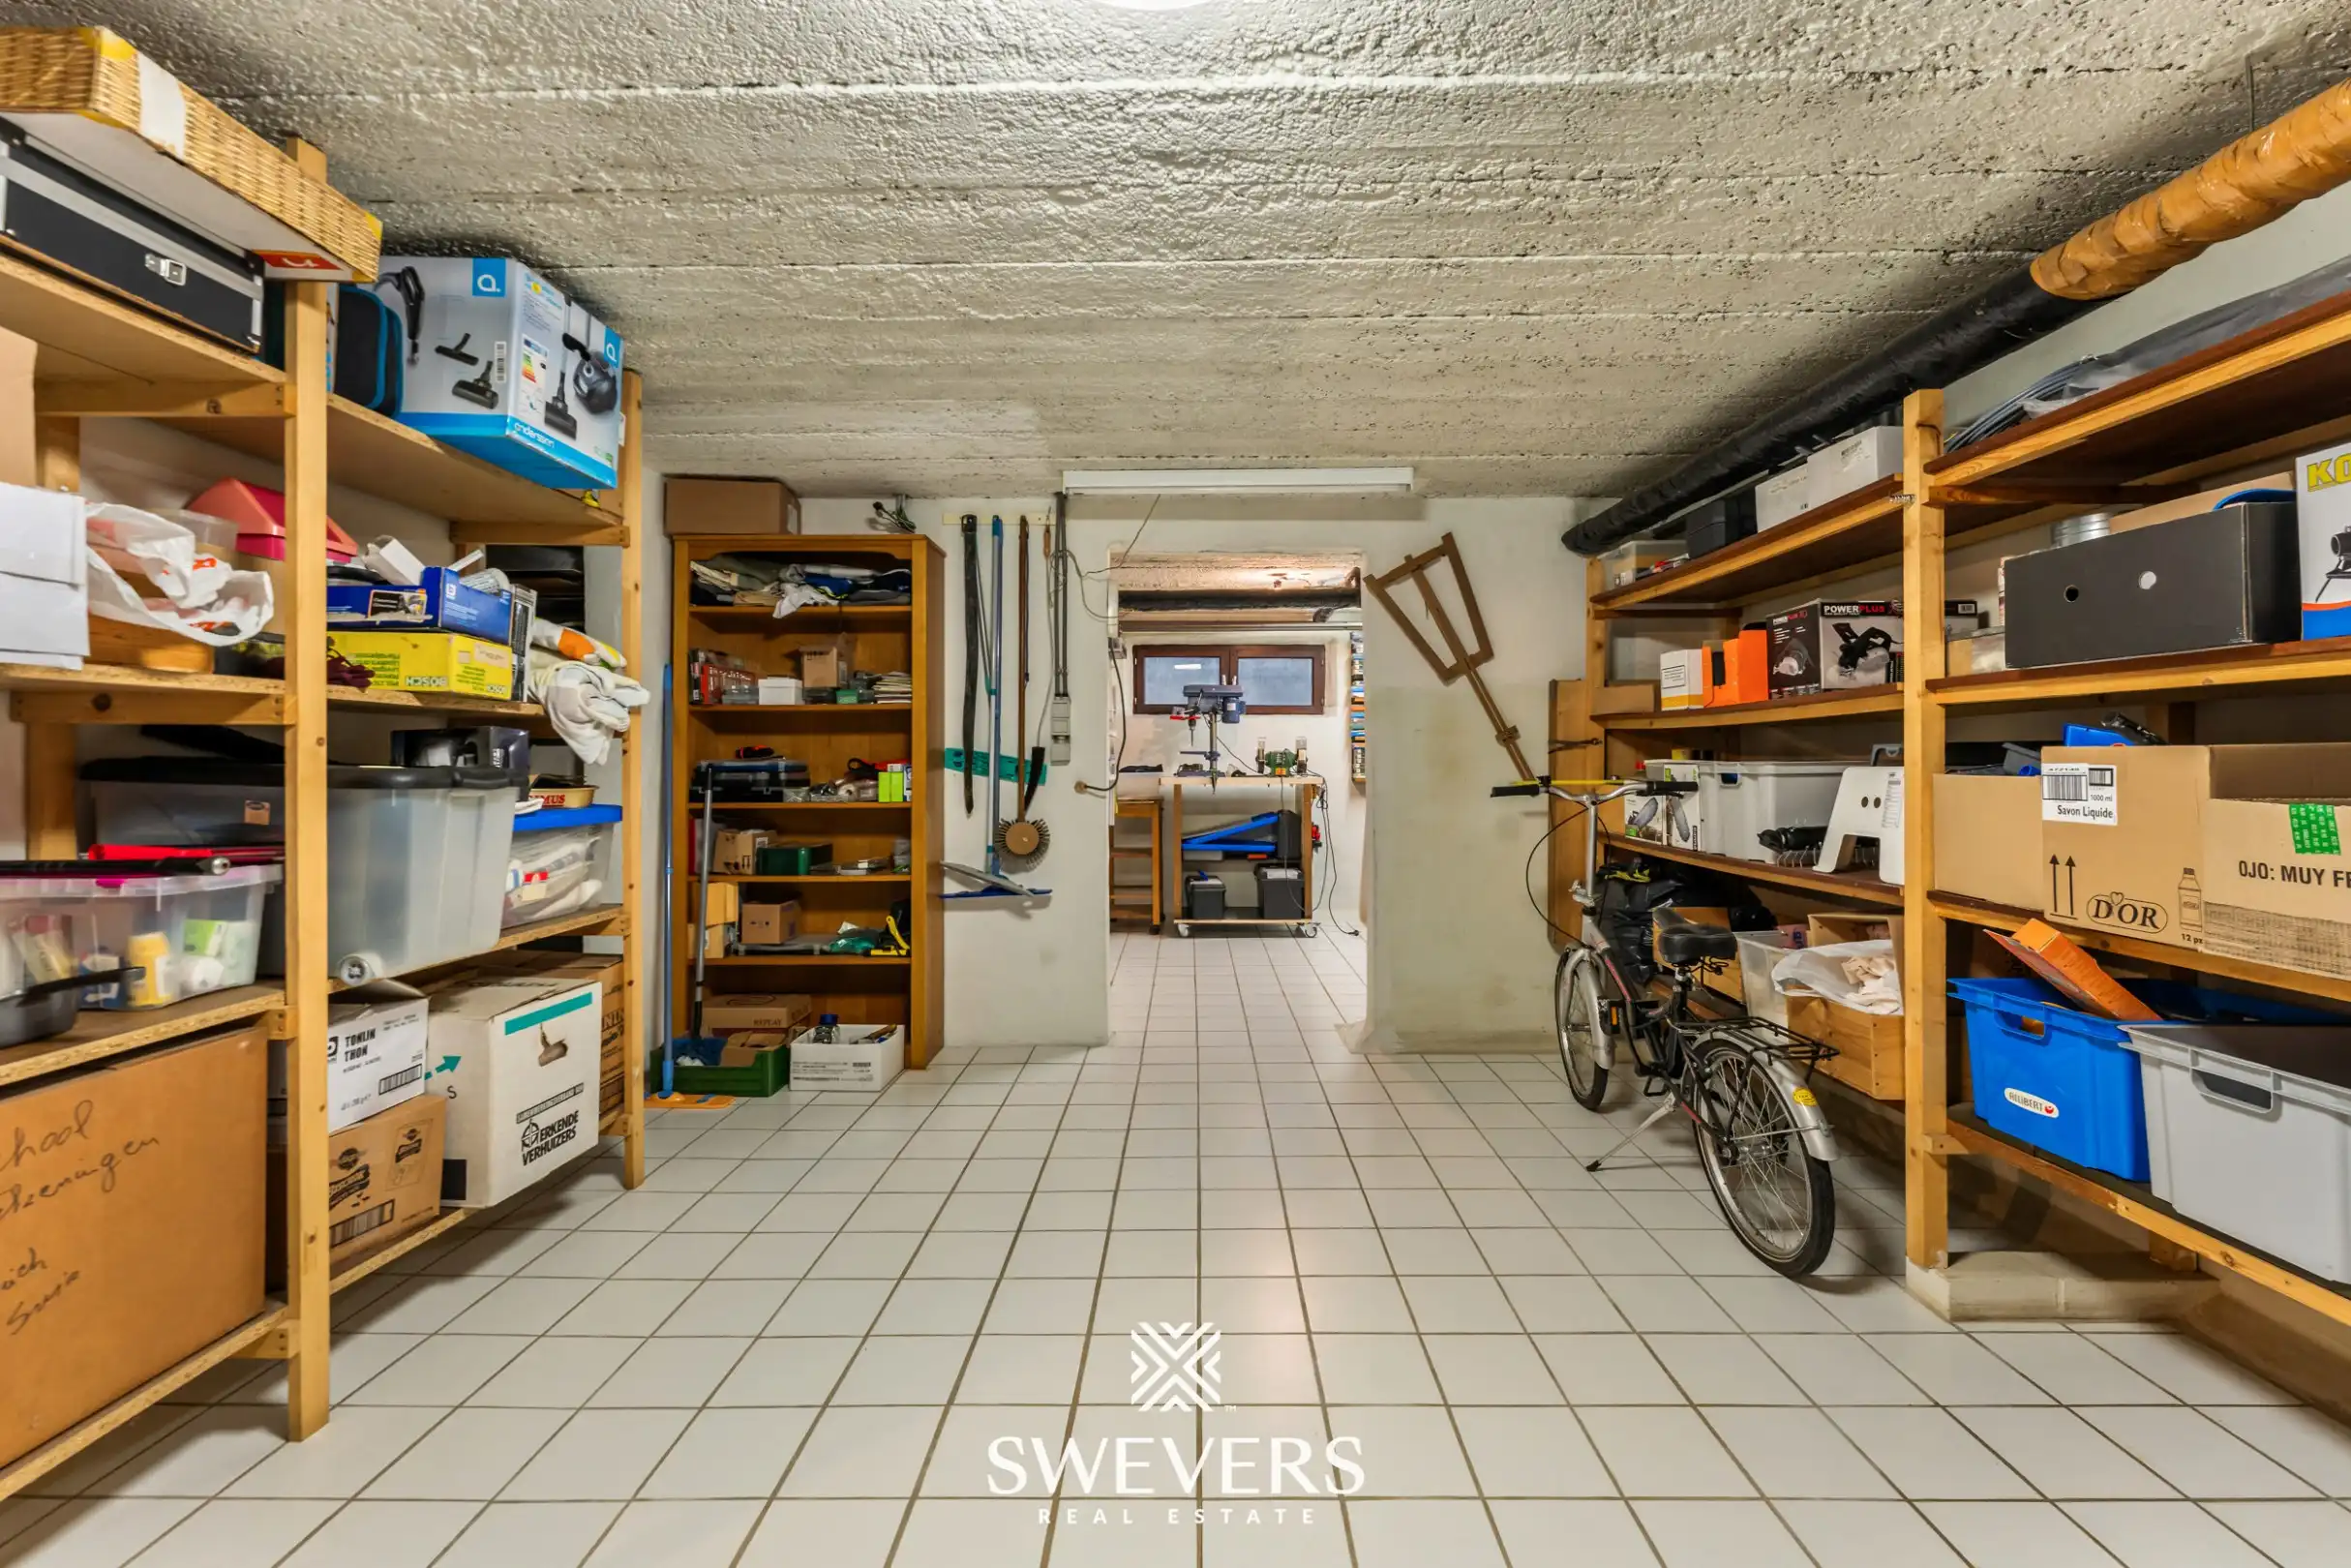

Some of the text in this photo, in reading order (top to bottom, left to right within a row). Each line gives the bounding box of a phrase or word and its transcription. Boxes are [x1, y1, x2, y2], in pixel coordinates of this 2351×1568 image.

[1824, 605, 1884, 614] POWERPLUS
[2058, 804, 2113, 820] Savon Liquide
[2239, 859, 2276, 881] OJO:
[2280, 864, 2325, 886] MUY
[2181, 933, 2192, 942] 12
[344, 1044, 369, 1063] THON
[447, 1085, 457, 1100] S
[539, 1109, 580, 1142] ERKENDE
[522, 1125, 578, 1166] VERHUIZERS
